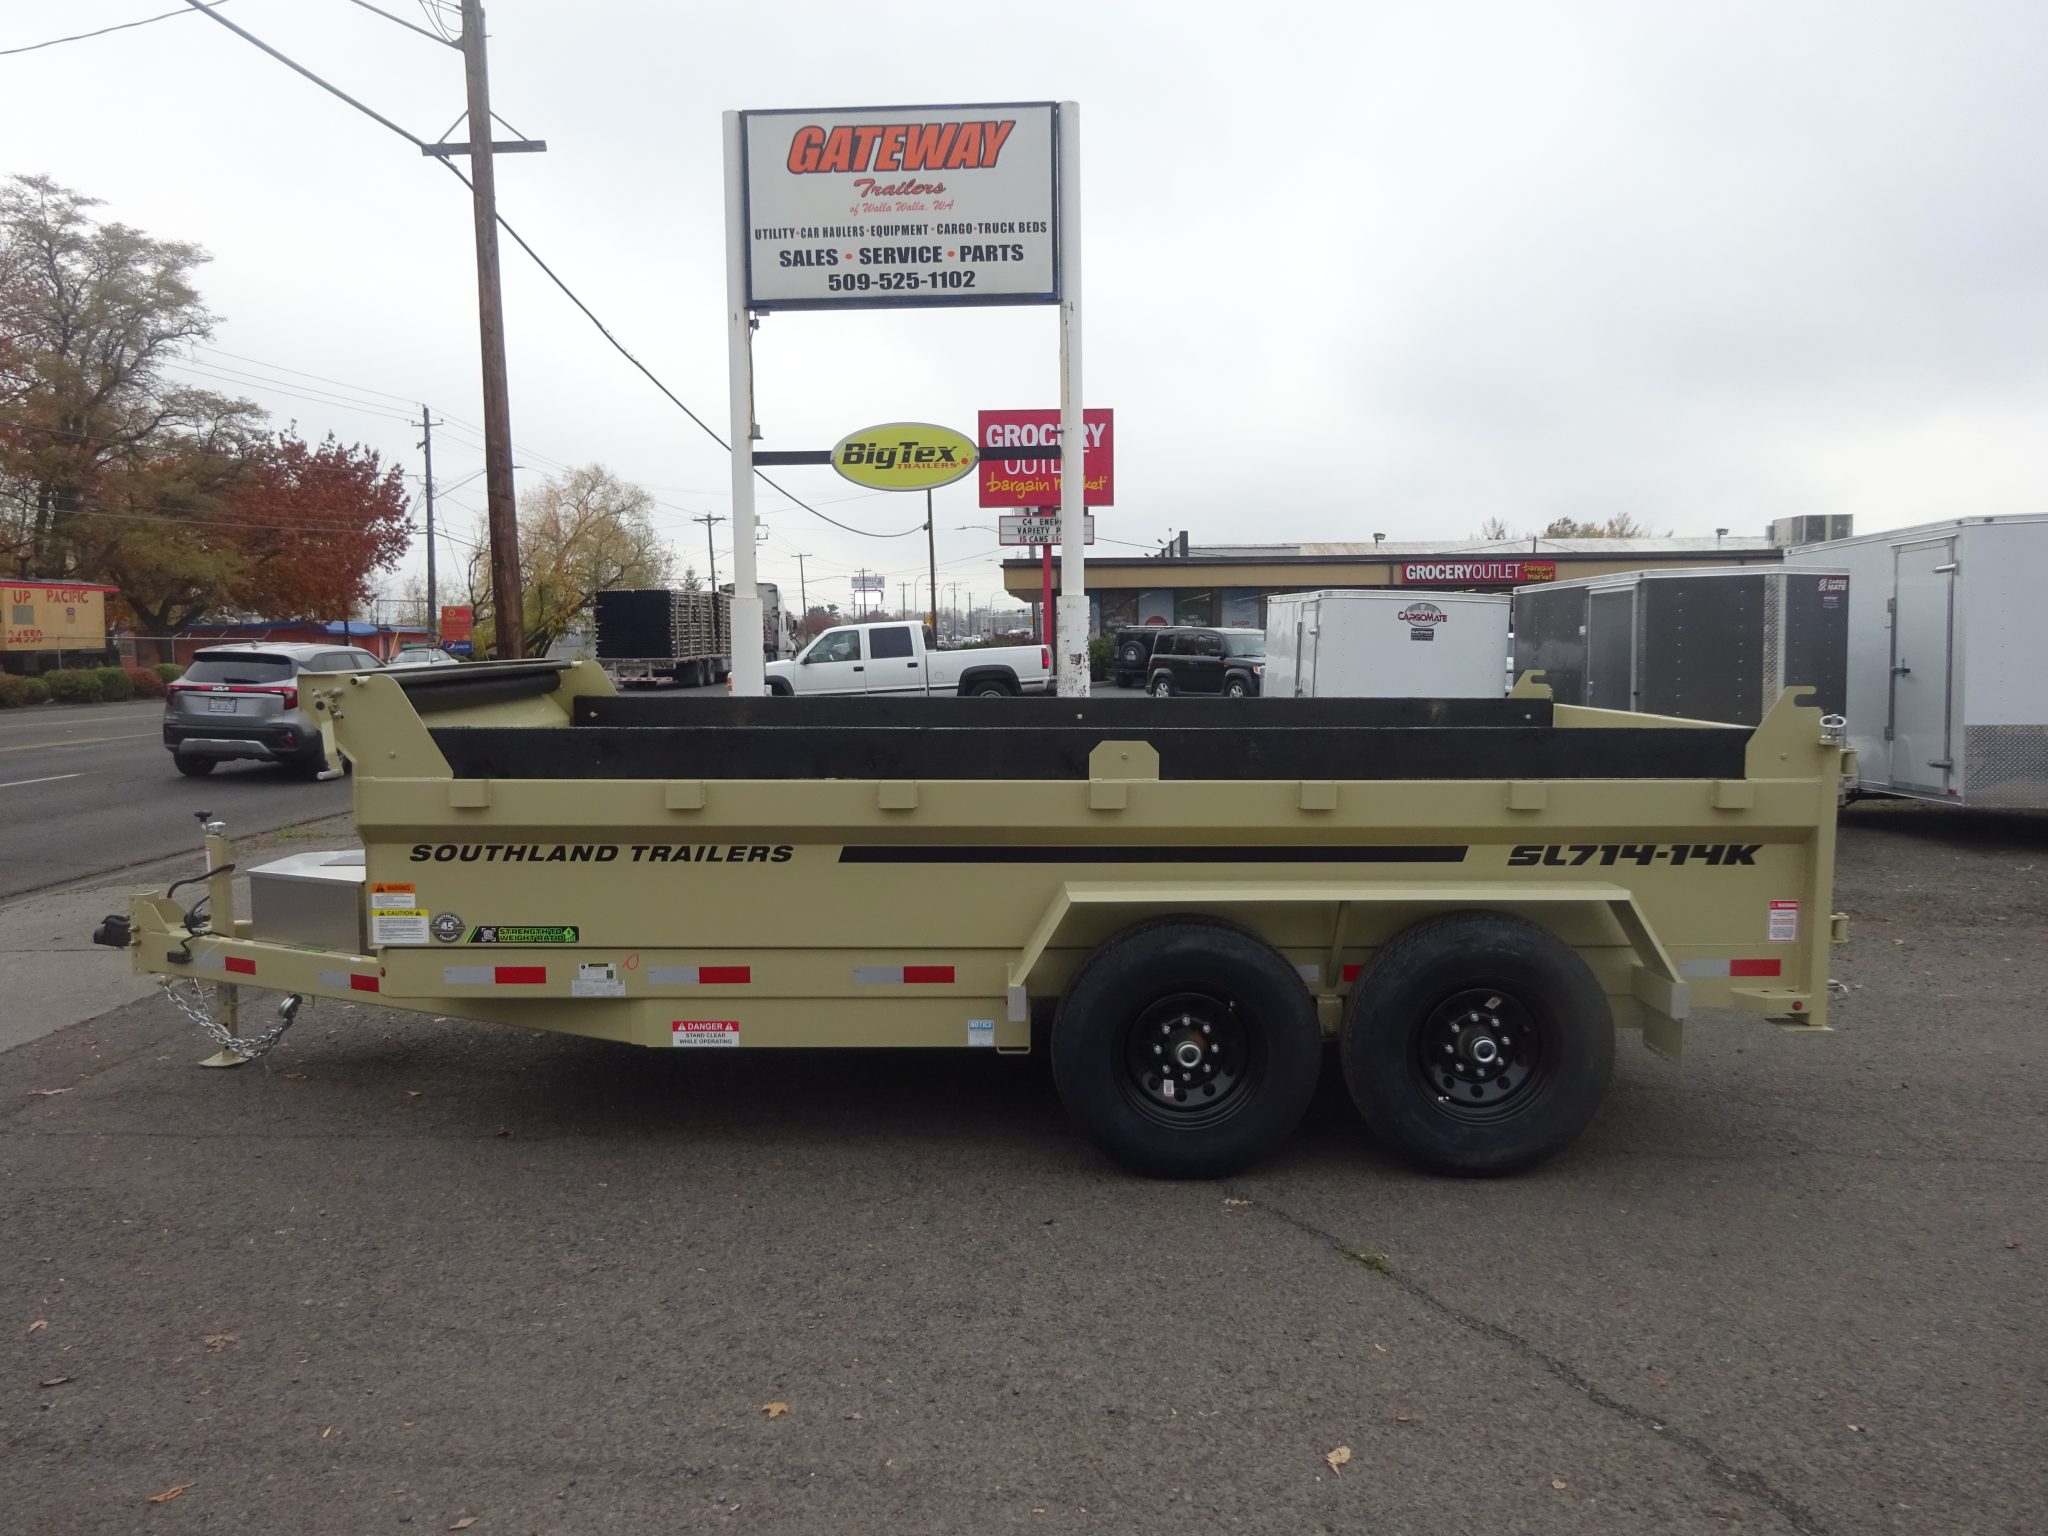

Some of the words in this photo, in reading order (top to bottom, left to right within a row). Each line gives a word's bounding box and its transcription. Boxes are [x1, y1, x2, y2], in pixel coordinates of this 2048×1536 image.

[787, 120, 1016, 175] GATEWAY
[853, 178, 947, 199] Trailers
[849, 206, 858, 216] of
[862, 202, 892, 214] Walla
[933, 200, 955, 211] WA
[754, 227, 796, 241] UTILITY
[800, 226, 820, 239] CAR
[822, 225, 866, 239] HAULERS
[870, 224, 929, 238] EQUIPMENT
[936, 223, 973, 236] CARGO
[977, 222, 1016, 235] TRUCK
[1018, 221, 1048, 234] BEDS
[779, 248, 839, 268] SALES
[859, 246, 943, 265] SERVICE
[959, 243, 1025, 263] PARTS
[828, 270, 976, 292] 509-525-1102
[986, 472, 1050, 499] bargain
[1017, 526, 1050, 534] VARIETY
[1022, 518, 1033, 526] C4
[1039, 518, 1062, 526] ENER
[1029, 535, 1049, 543] CANS
[13, 590, 31, 604] UP
[46, 590, 89, 604] PACIFIC
[409, 844, 619, 863] SOUTHLAND
[630, 844, 794, 863] TRAILERS
[1507, 844, 1764, 866] SL714-14K
[441, 921, 454, 931] 45
[499, 927, 549, 935] STRENGTH
[549, 927, 562, 935] TO
[687, 1022, 723, 1031] DANGER
